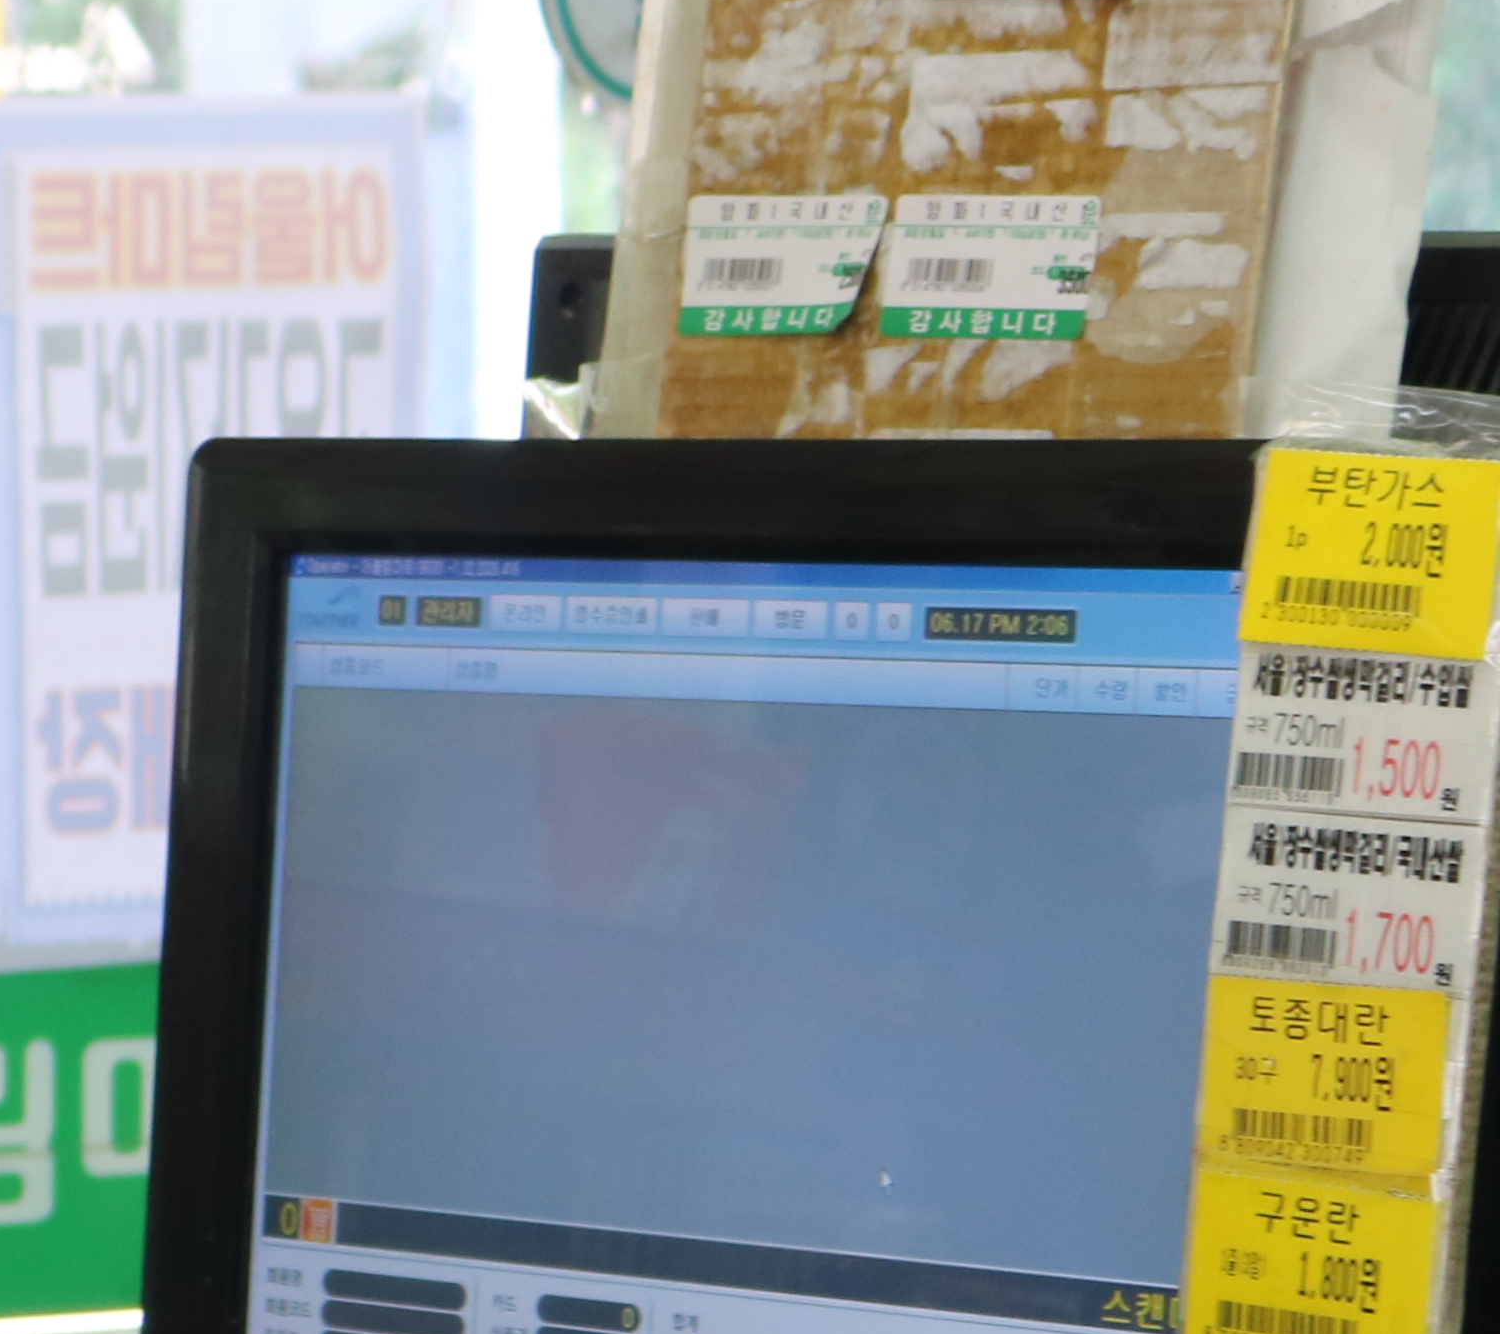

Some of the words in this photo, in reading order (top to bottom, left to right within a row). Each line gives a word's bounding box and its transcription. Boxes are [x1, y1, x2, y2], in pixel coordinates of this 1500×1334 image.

[704, 306, 836, 332] 감사합니다
[908, 309, 1057, 336] 감사합니다
[1306, 465, 1445, 510] 부탄가스
[1360, 521, 1449, 578] 2,000원
[929, 612, 985, 634] 06.17
[989, 613, 1021, 635] PM
[1275, 712, 1346, 749] 750ml
[1353, 735, 1443, 801] 1,500
[1440, 787, 1461, 812] 원
[1268, 882, 1340, 918] 750ml
[1345, 908, 1436, 975] 1,700
[1434, 962, 1455, 987] 원
[1248, 994, 1392, 1047] 토종대란
[1233, 1055, 1279, 1085] 30구
[1309, 1053, 1396, 1113] 7,900원
[1254, 1190, 1361, 1246] 구운란
[1295, 1250, 1383, 1315] 1,800원
